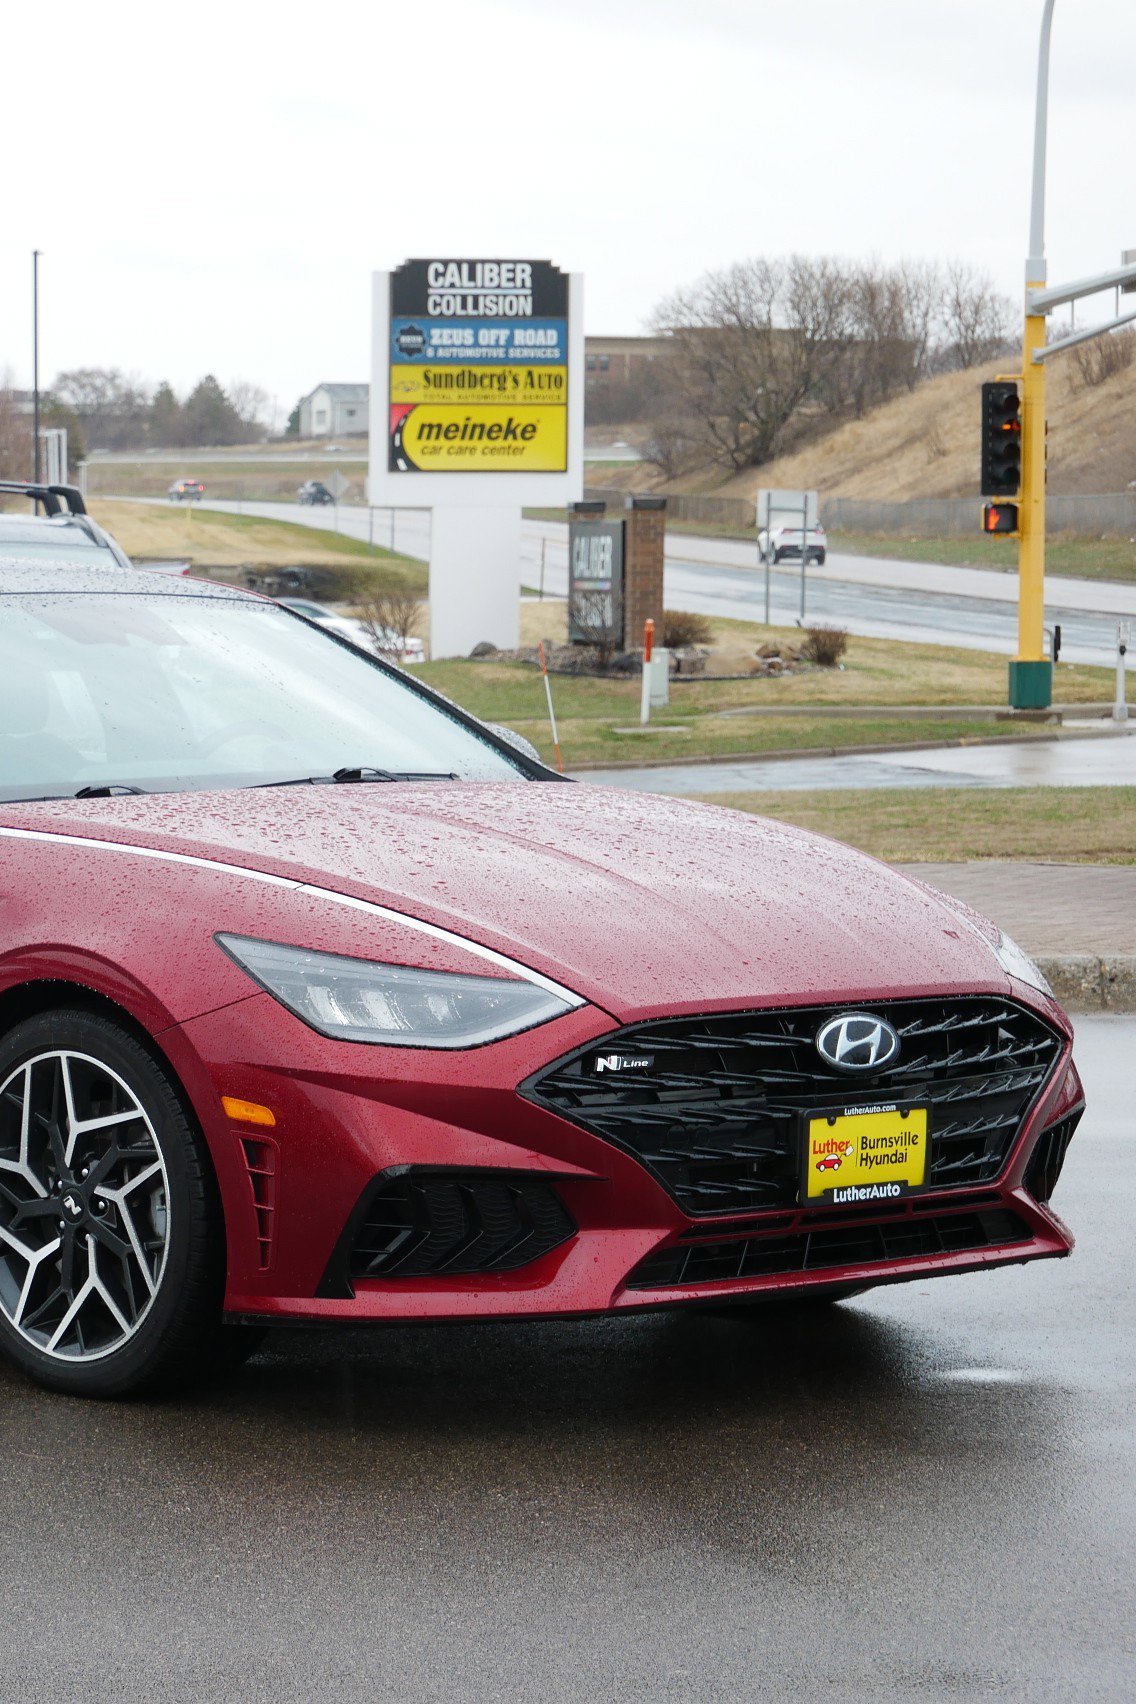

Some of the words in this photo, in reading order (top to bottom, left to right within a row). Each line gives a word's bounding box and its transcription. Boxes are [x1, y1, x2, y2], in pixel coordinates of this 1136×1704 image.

[427, 262, 532, 288] CALIBER
[427, 295, 533, 317] COLLISION
[430, 328, 474, 346] ZEUS
[478, 328, 510, 346] OFF
[513, 328, 558, 346] ROAD
[437, 347, 506, 359] AUTOMOTIVE
[508, 347, 561, 359] SERVICES
[423, 368, 520, 391] Sundberg's
[417, 417, 537, 441] meineke
[420, 444, 442, 456] car
[447, 444, 477, 456] care
[481, 443, 526, 456] center
[623, 1060, 649, 1068] Line
[844, 1104, 896, 1116] LutherAuto.com
[812, 1138, 850, 1155] Luther
[860, 1131, 919, 1151] Burnsville
[859, 1148, 908, 1169] Hyundai
[833, 1183, 901, 1203] LutherAuto
